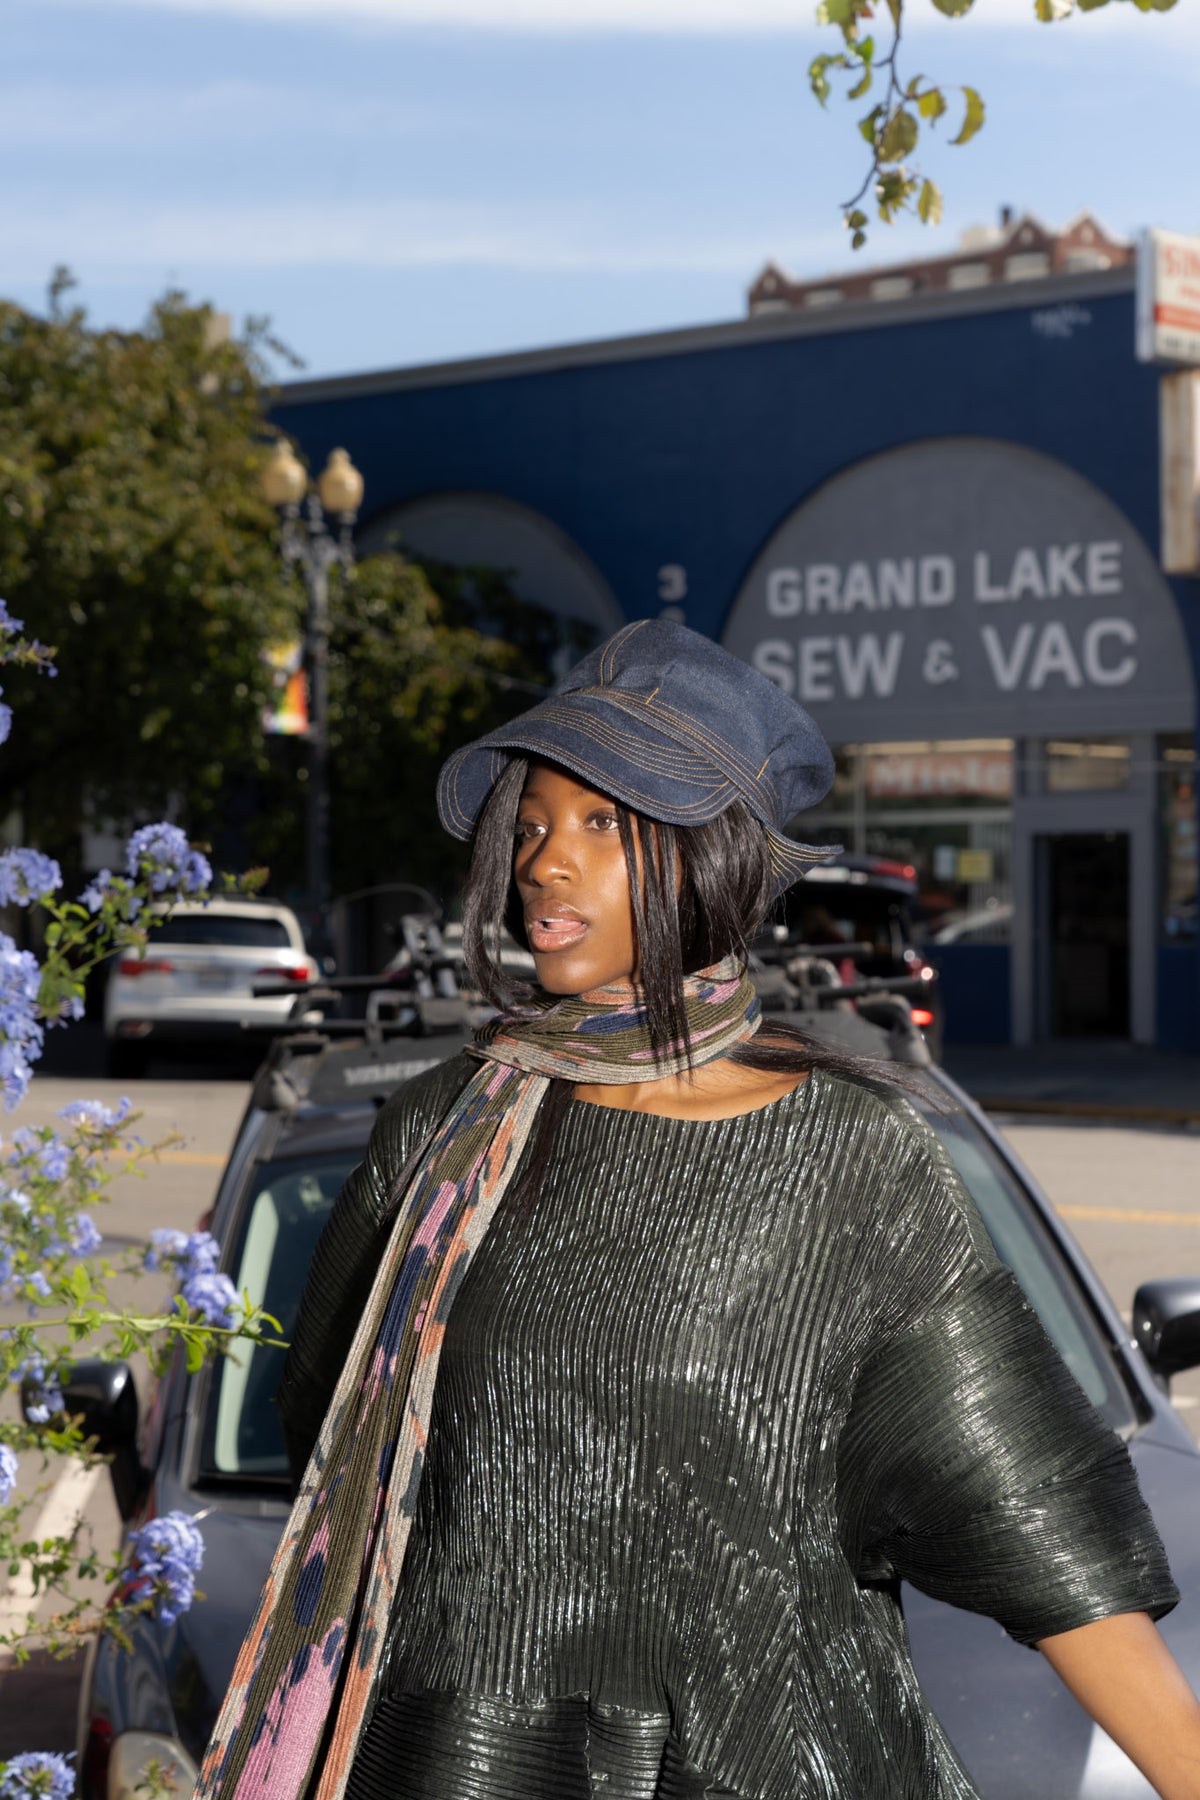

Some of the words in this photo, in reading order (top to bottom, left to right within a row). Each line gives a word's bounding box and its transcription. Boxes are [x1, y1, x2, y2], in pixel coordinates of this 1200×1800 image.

[657, 563, 688, 601] 3
[766, 554, 956, 617] GRAND
[973, 541, 1123, 602] LAKE
[752, 632, 903, 702] SEW
[923, 638, 958, 684] &
[981, 617, 1138, 690] VAC
